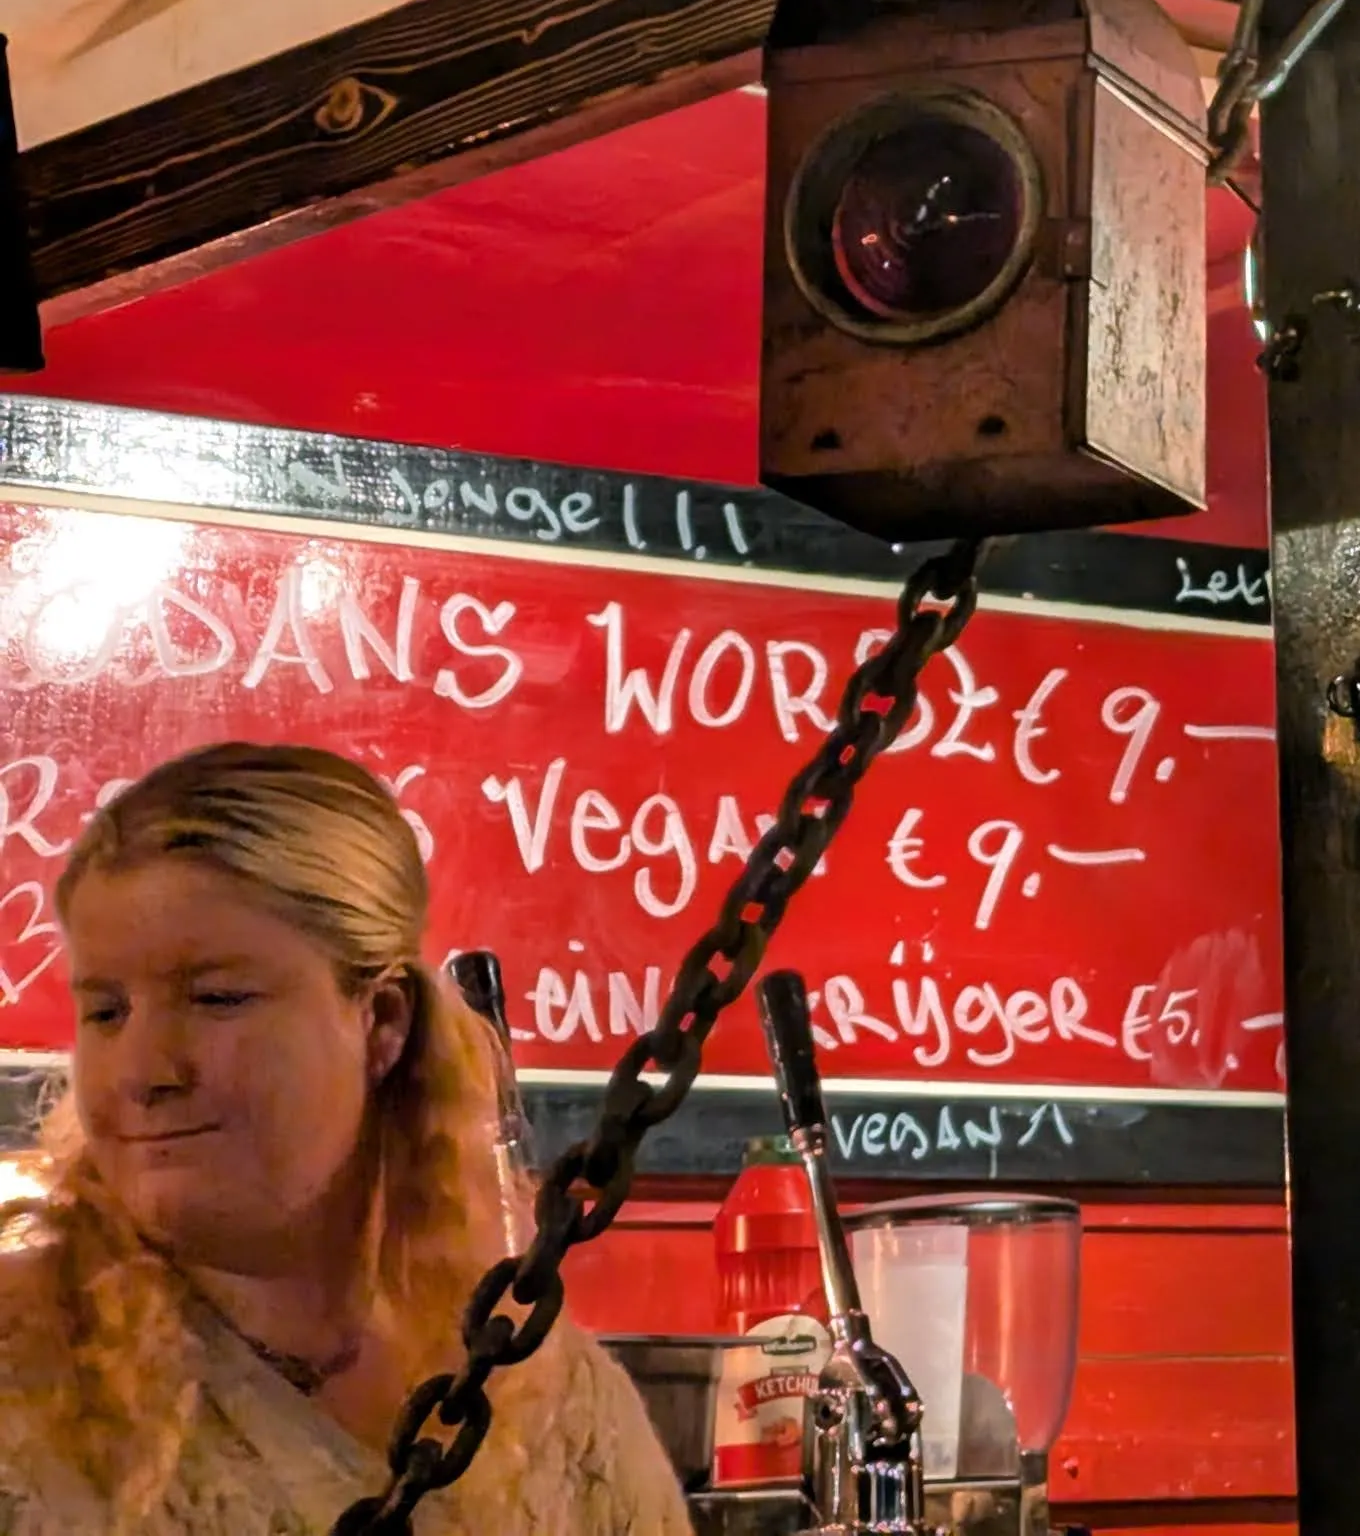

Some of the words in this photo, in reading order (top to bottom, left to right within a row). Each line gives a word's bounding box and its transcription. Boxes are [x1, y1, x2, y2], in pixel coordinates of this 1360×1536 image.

[1176, 556, 1273, 606] Lek
[0, 562, 524, 710] ODANS
[754, 1374, 821, 1401] KETCHU
